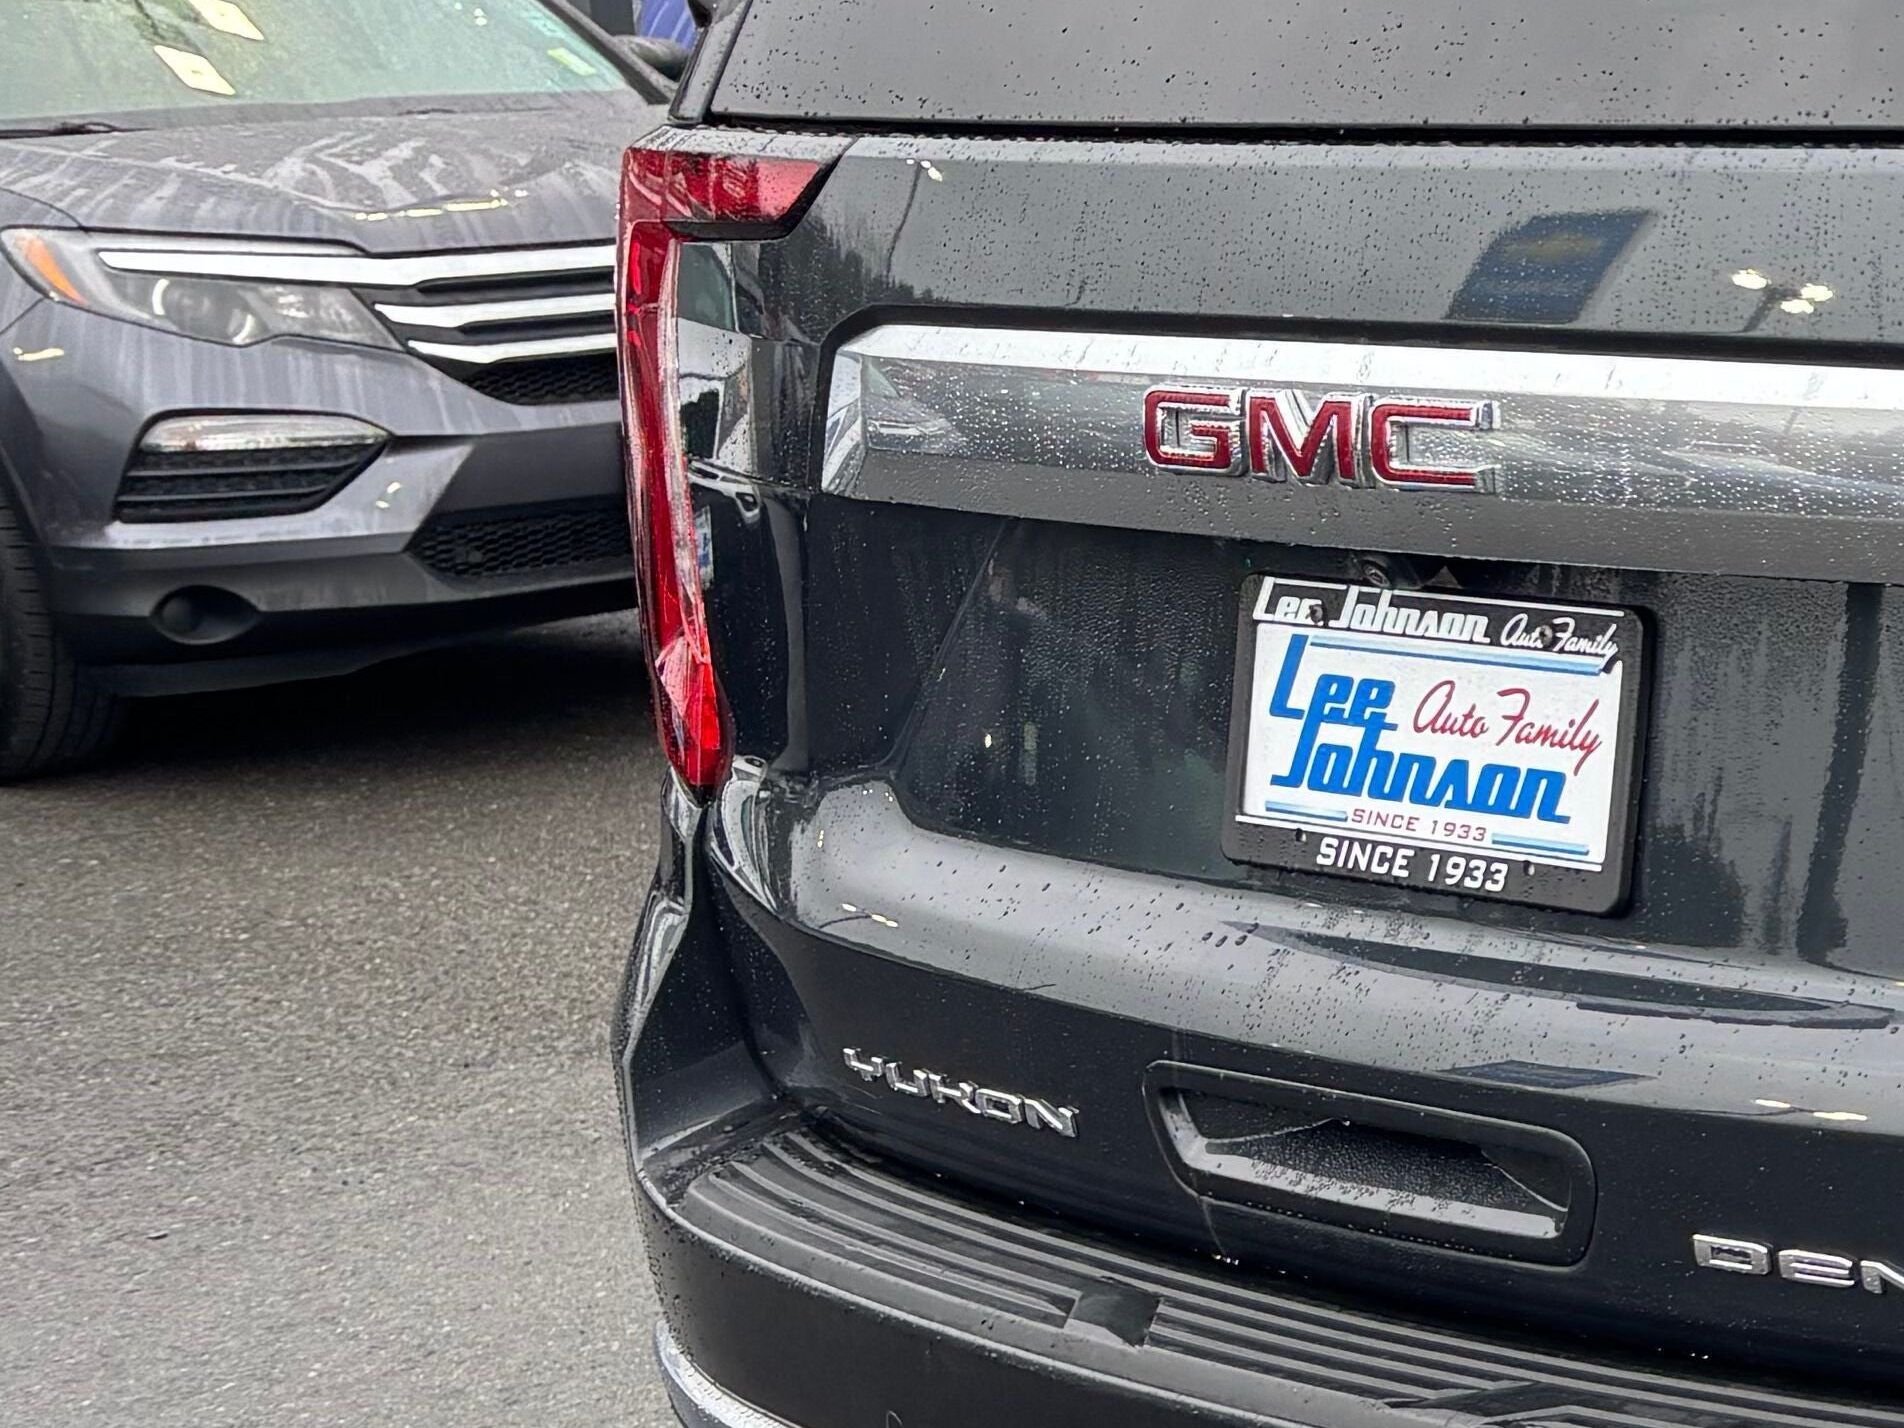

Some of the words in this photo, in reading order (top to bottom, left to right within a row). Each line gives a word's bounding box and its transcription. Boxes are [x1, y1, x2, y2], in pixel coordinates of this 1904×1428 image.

[1143, 382, 1499, 493] GMC
[1328, 584, 1491, 644] Johnson
[1501, 613, 1553, 649] Aut
[1552, 617, 1618, 670] Family
[1268, 633, 1397, 732] Lee
[1412, 679, 1489, 739] Auto
[1496, 687, 1602, 776] Family
[1269, 720, 1571, 825] Johnson
[1316, 836, 1415, 879] SINCE
[1427, 853, 1509, 893] 1933
[1351, 808, 1420, 832] SINCE
[1431, 820, 1487, 843] 1933
[843, 1047, 1079, 1138] YUKON
